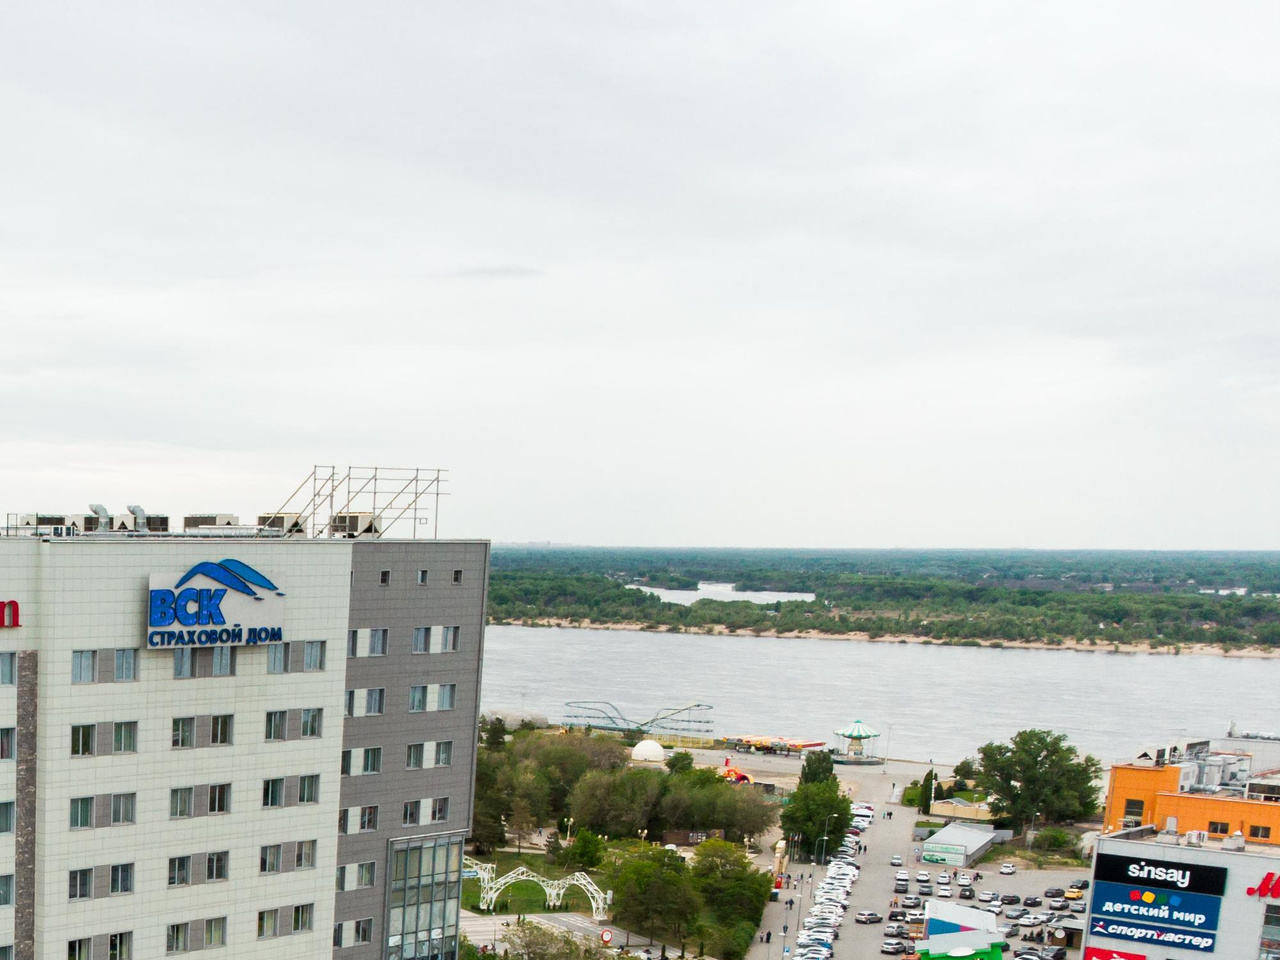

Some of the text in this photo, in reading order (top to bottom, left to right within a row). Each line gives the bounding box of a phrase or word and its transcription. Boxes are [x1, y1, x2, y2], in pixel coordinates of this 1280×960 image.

[149, 588, 227, 627] ВСК
[148, 624, 283, 647] СТРАХОВОЙ ДОМ
[1128, 861, 1191, 888] sinsay
[1102, 900, 1207, 926] детский мир
[1107, 924, 1214, 948] спортмастер
